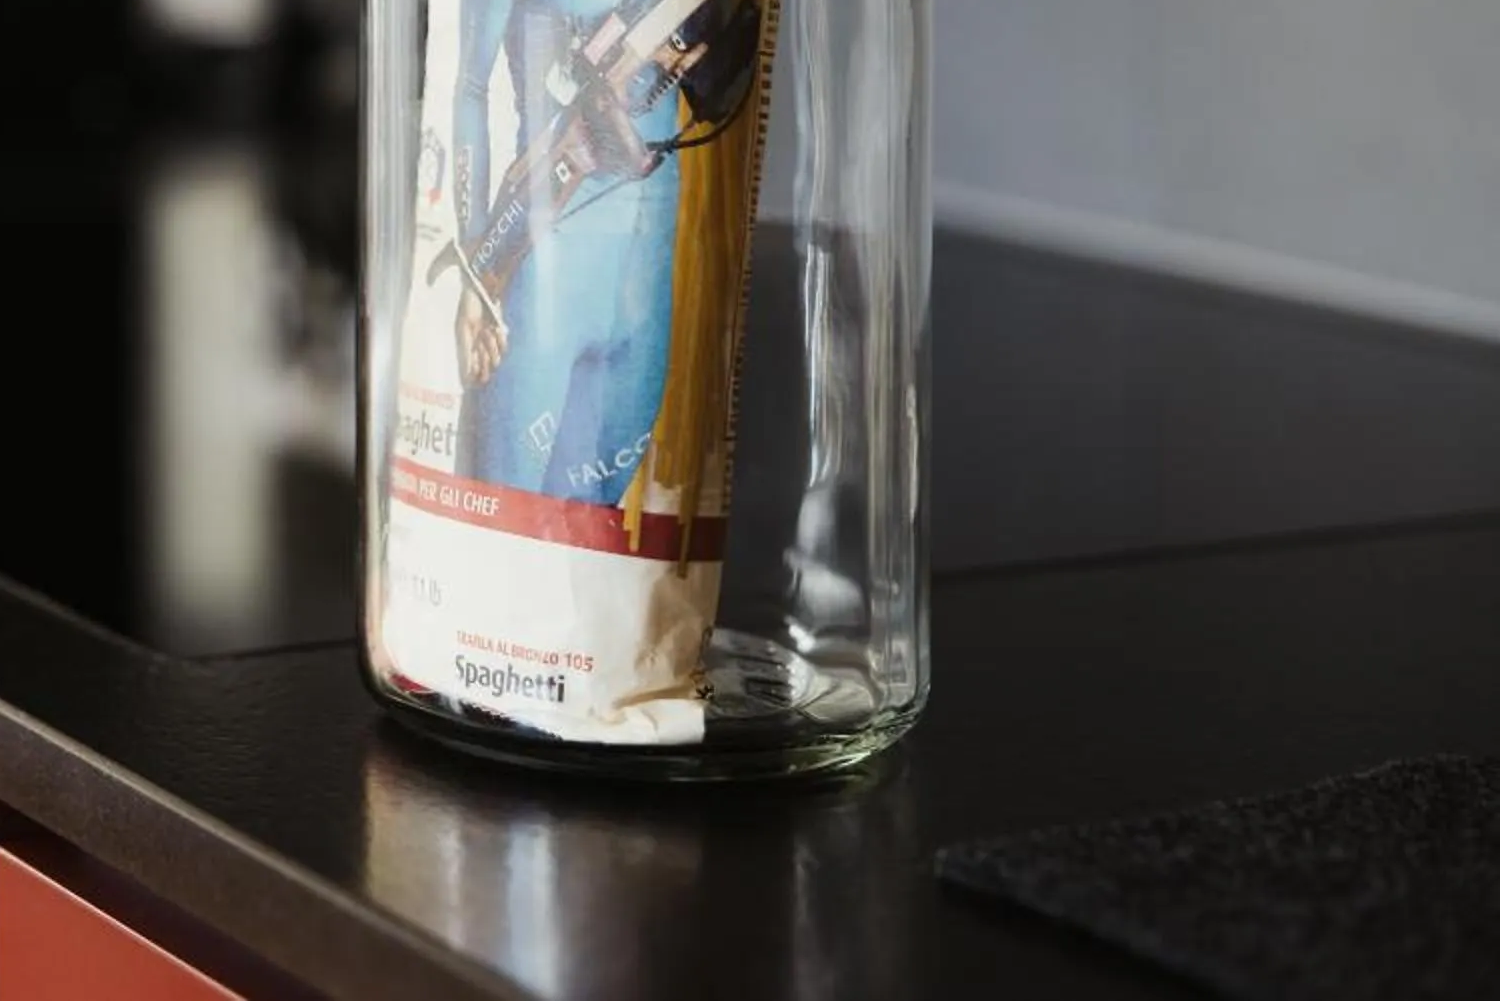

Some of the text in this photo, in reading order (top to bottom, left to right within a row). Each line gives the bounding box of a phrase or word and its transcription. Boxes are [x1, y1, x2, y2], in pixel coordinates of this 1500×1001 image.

[463, 490, 500, 516] CHEF
[564, 652, 595, 673] 105
[455, 655, 566, 704] Spaghetti
